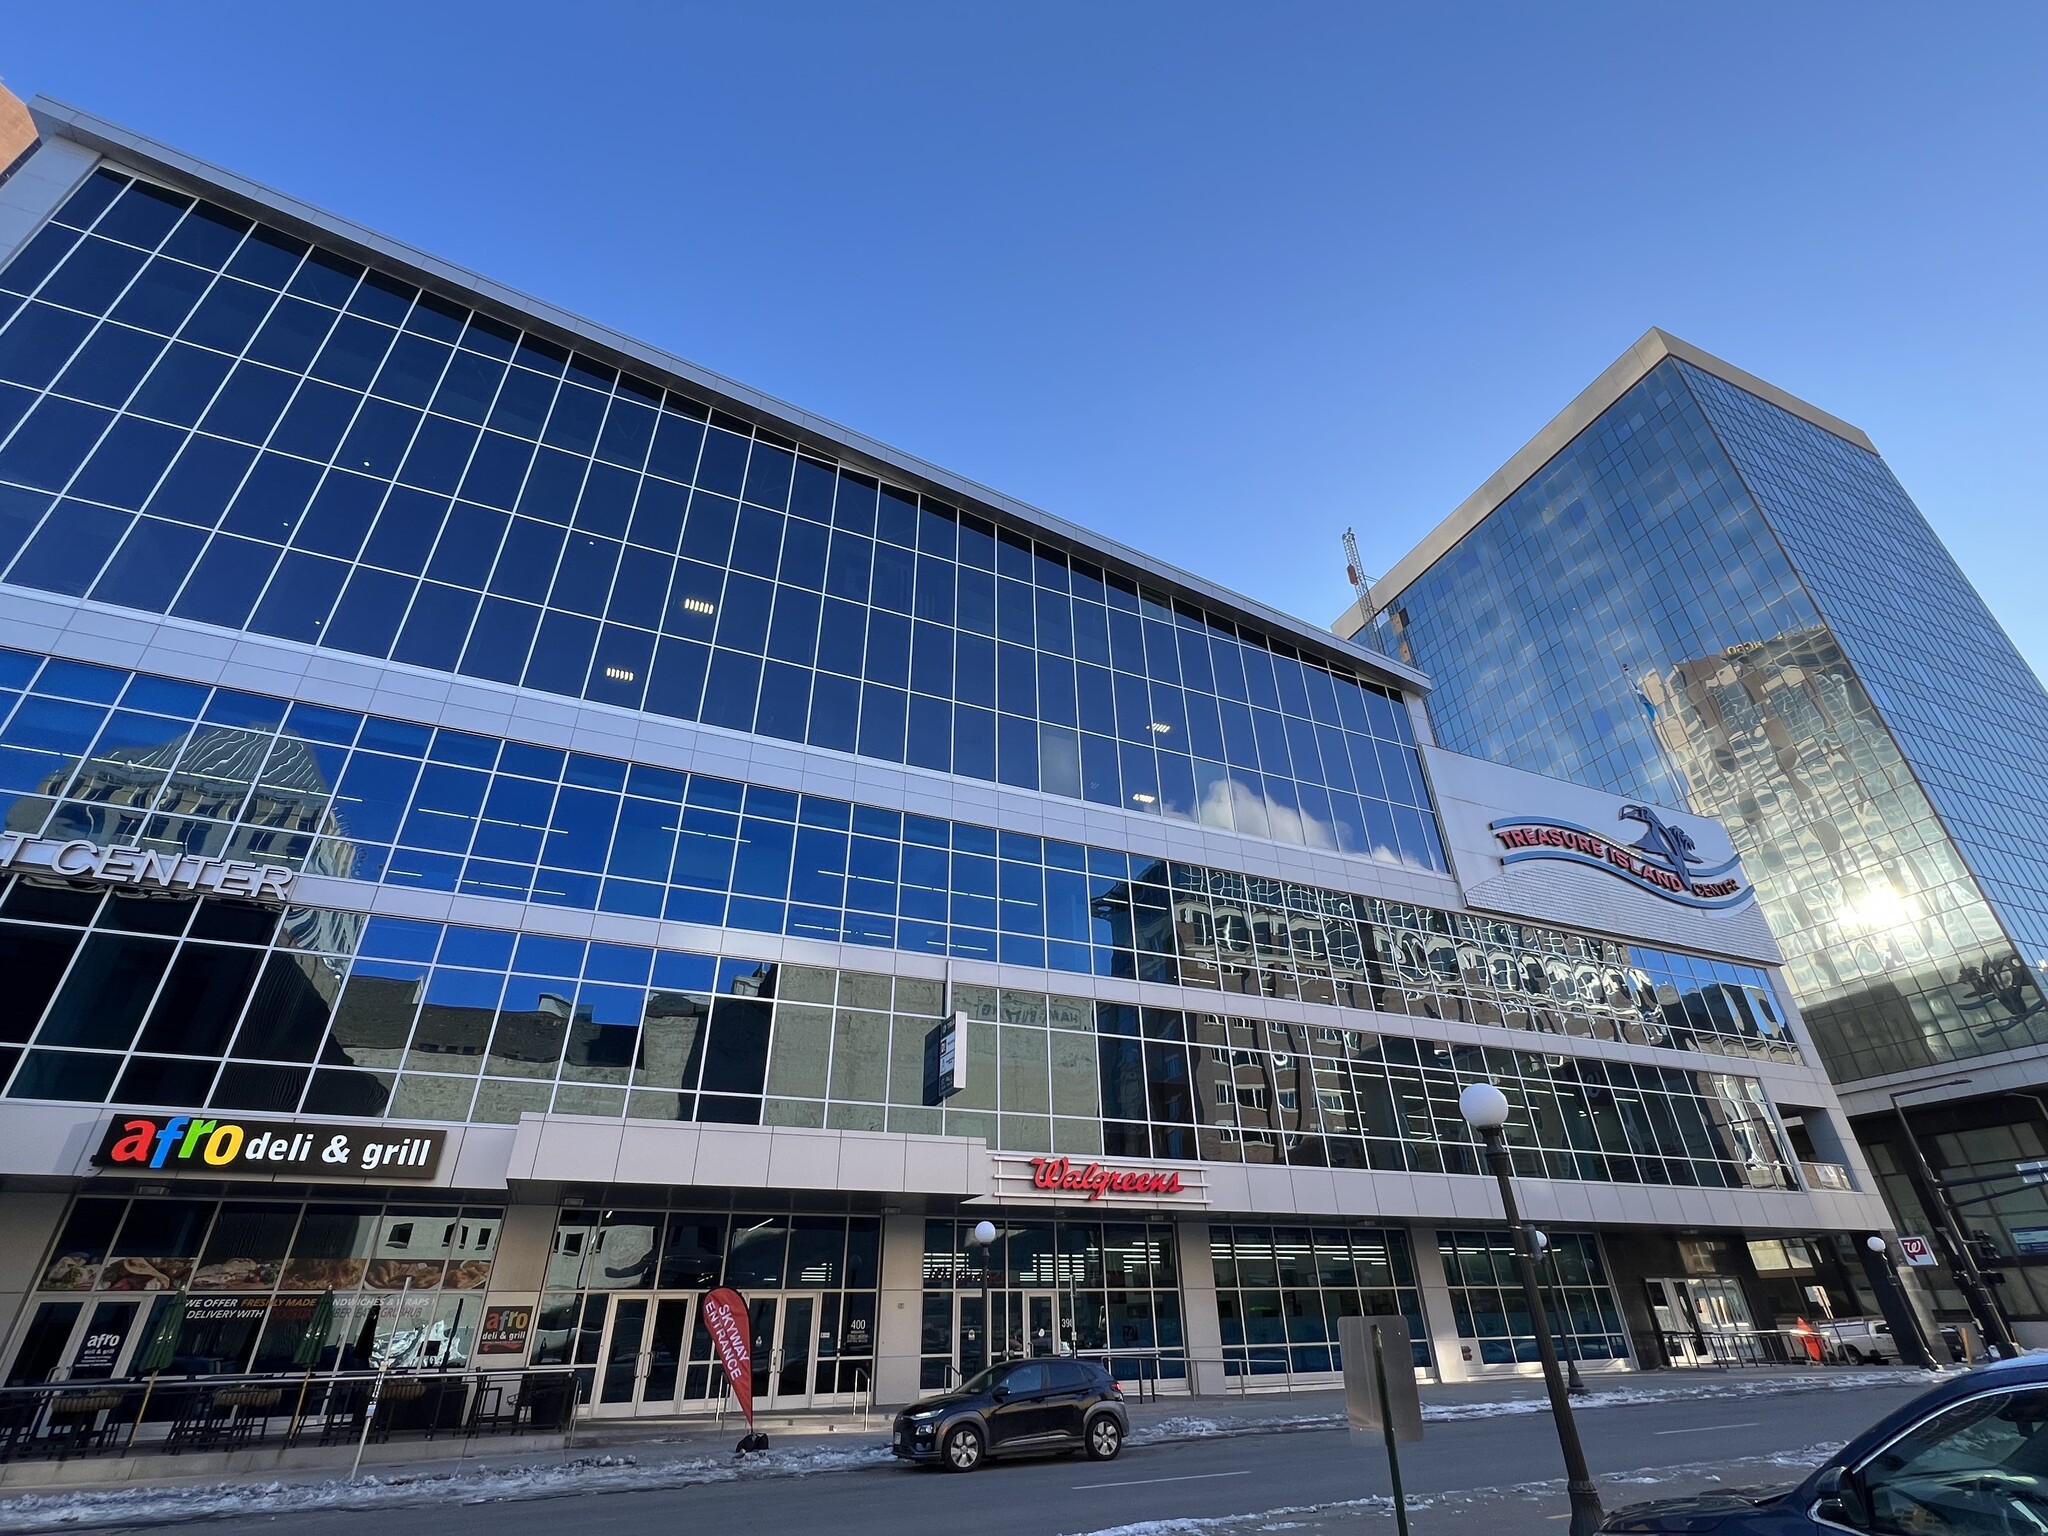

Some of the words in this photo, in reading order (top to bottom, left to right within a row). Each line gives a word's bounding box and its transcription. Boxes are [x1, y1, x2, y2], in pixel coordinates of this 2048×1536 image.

[51, 839, 294, 900] CENTER
[1498, 828, 1604, 857] TREASURE
[1607, 847, 1684, 892] ISLAND
[1692, 878, 1740, 898] CENTER
[110, 1115, 244, 1169] afro
[245, 1131, 314, 1161] deli
[320, 1134, 351, 1164] &
[360, 1138, 431, 1170] grill
[1030, 1156, 1185, 1201] Walgreens
[185, 1309, 237, 1319] DELIVERY
[236, 1309, 265, 1318] WITH
[203, 1299, 239, 1308] OFFER
[285, 1298, 318, 1307] MADE
[482, 1332, 498, 1340] deli
[499, 1331, 507, 1340] &
[508, 1331, 527, 1341] grill
[485, 1310, 529, 1331] afro
[718, 1303, 750, 1362] SKYWAY
[850, 1319, 866, 1330] 400
[87, 1333, 120, 1348] afro
[705, 1301, 742, 1381] ENTRANCE
